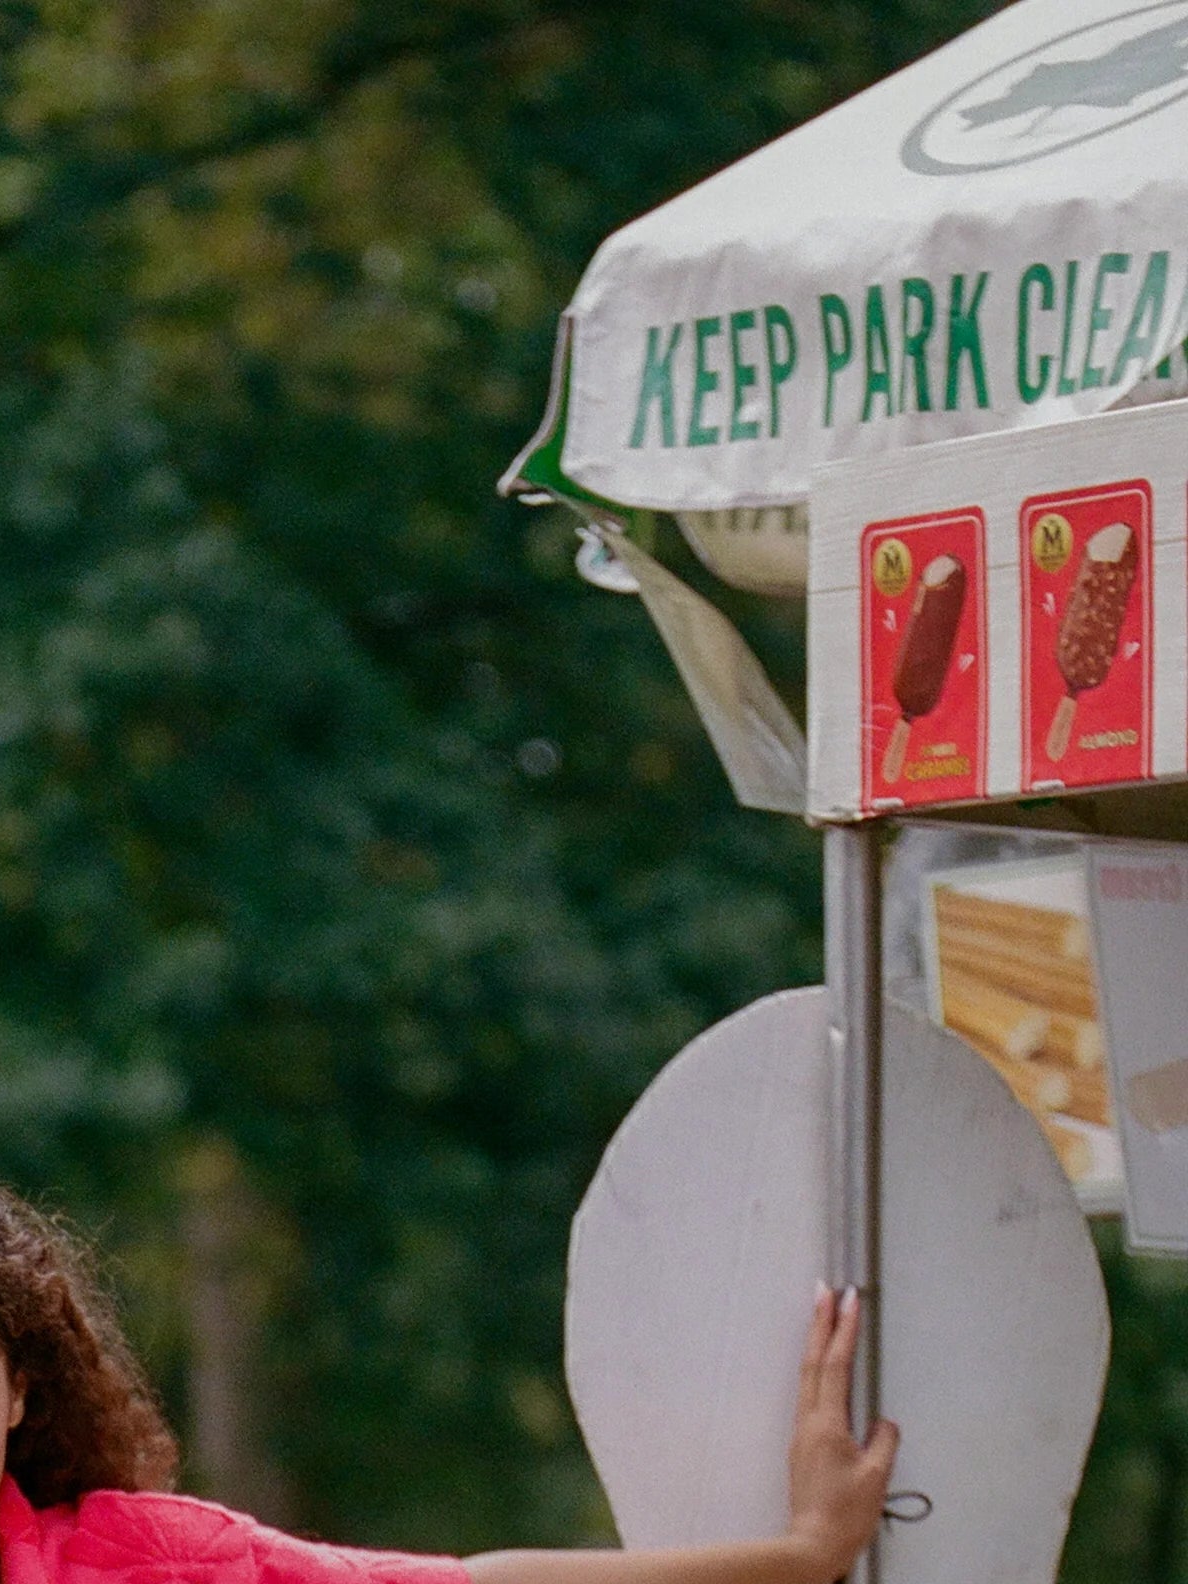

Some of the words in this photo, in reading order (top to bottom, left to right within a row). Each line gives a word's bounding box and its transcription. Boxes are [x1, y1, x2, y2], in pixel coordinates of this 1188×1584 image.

[629, 304, 798, 448] KEEP
[819, 271, 989, 428] PARK
[1018, 251, 1188, 404] CLEA
